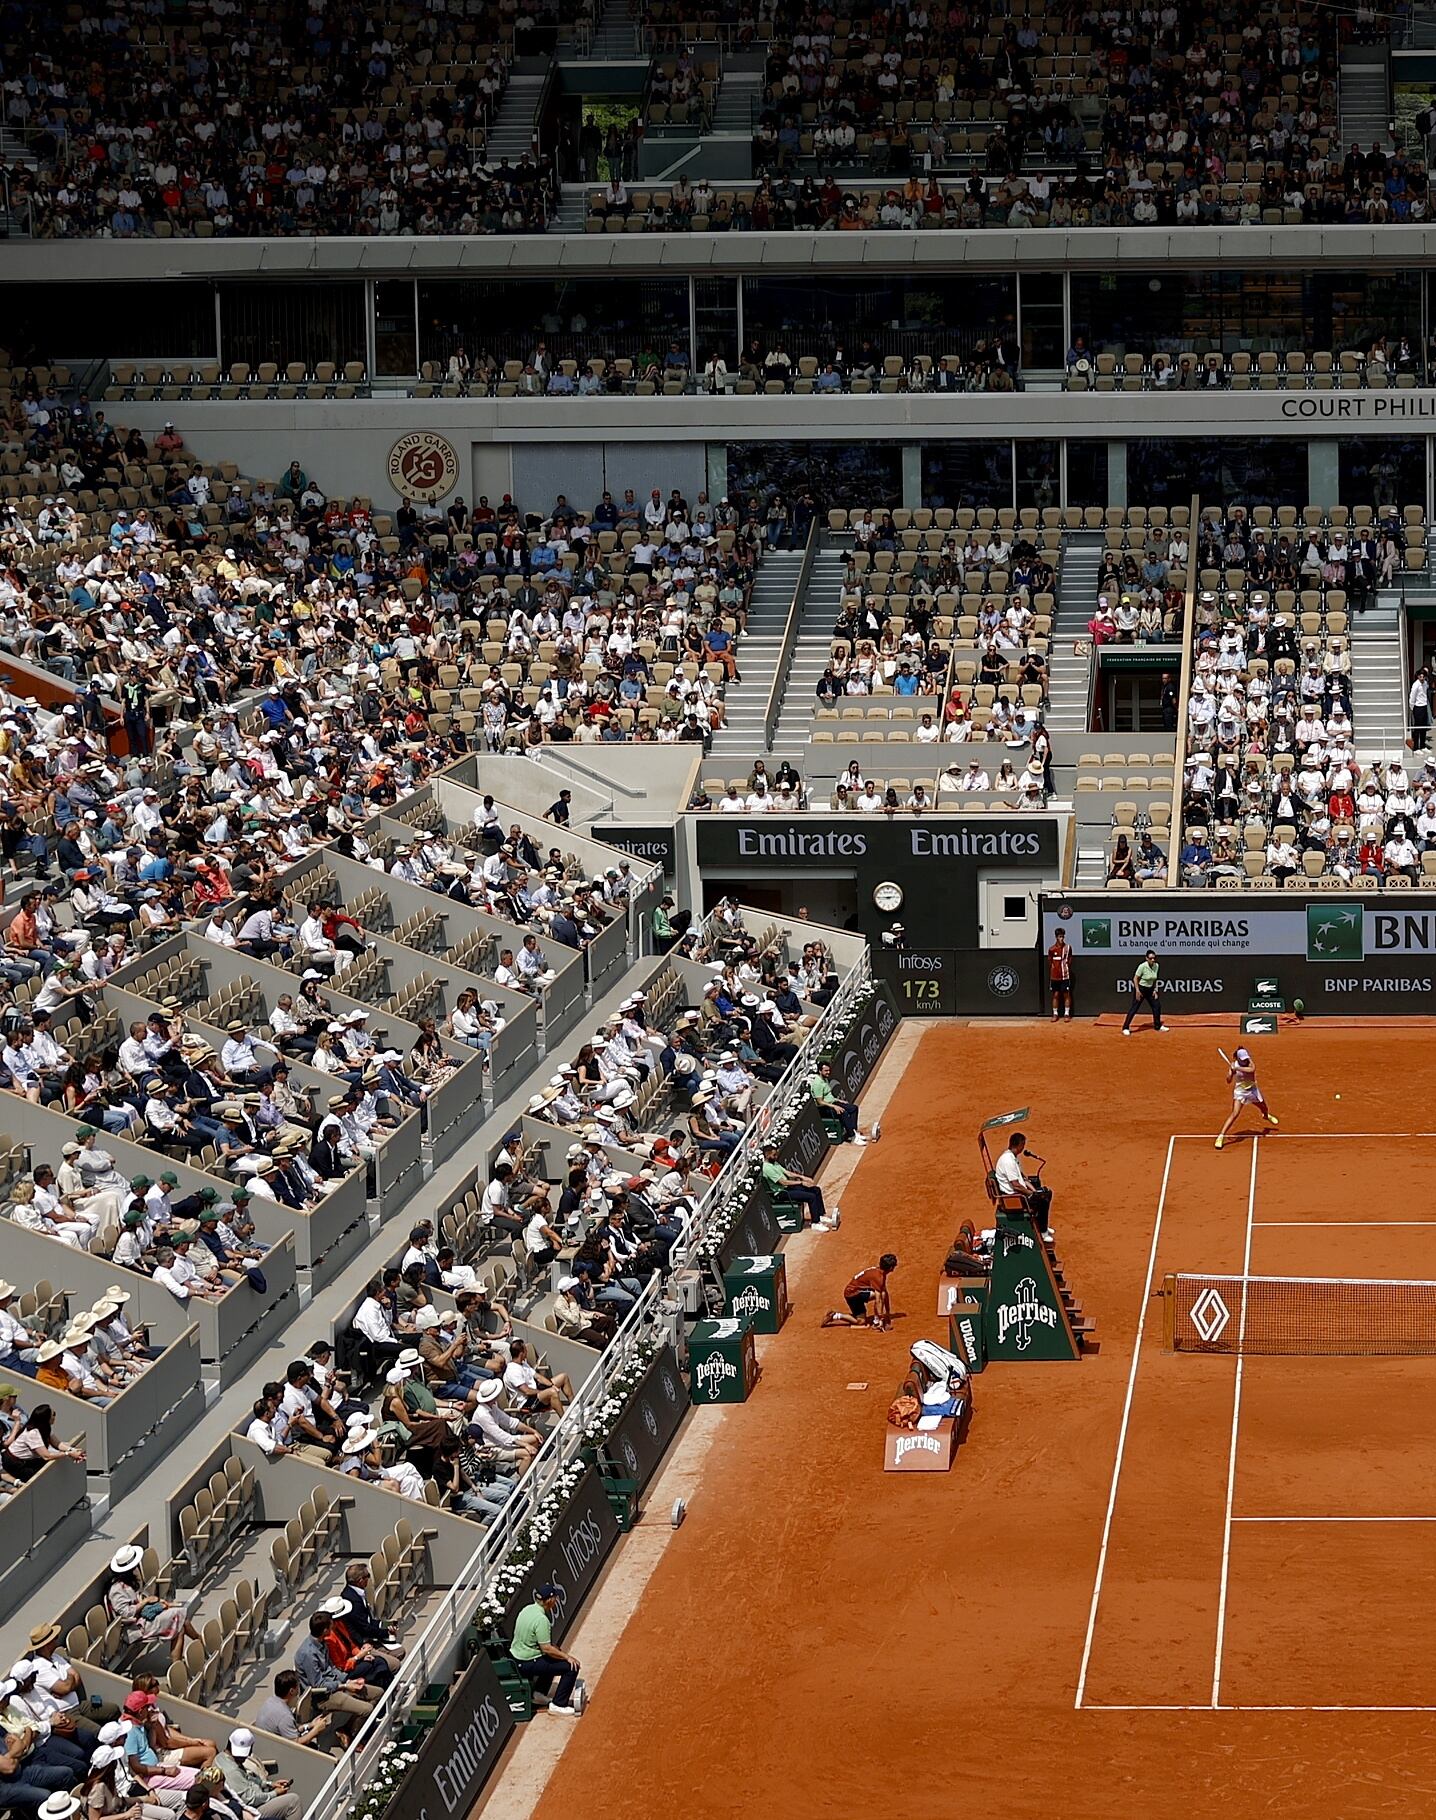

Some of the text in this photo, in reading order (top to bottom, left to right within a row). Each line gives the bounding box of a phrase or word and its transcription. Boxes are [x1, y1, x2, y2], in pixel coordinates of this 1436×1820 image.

[1281, 399, 1366, 416] COURT
[390, 435, 455, 476] ROLAND GARROS
[604, 840, 668, 855] mirates
[738, 828, 867, 855] Emirates
[910, 828, 1041, 855] Emirates
[1118, 920, 1250, 937] BNP PARIBAS
[1129, 940, 1158, 949] banque
[1207, 940, 1220, 949] qui
[1221, 940, 1250, 949] change
[899, 954, 942, 971] Infosys
[903, 980, 940, 998] 173
[1116, 979, 1223, 993] BN PARIBAS
[1324, 978, 1432, 992] BNP PARIBAS
[916, 1000, 942, 1009] km/h
[960, 1318, 977, 1363] Wilson
[560, 1508, 602, 1582] Infosys
[433, 1694, 500, 1814] Emirates
